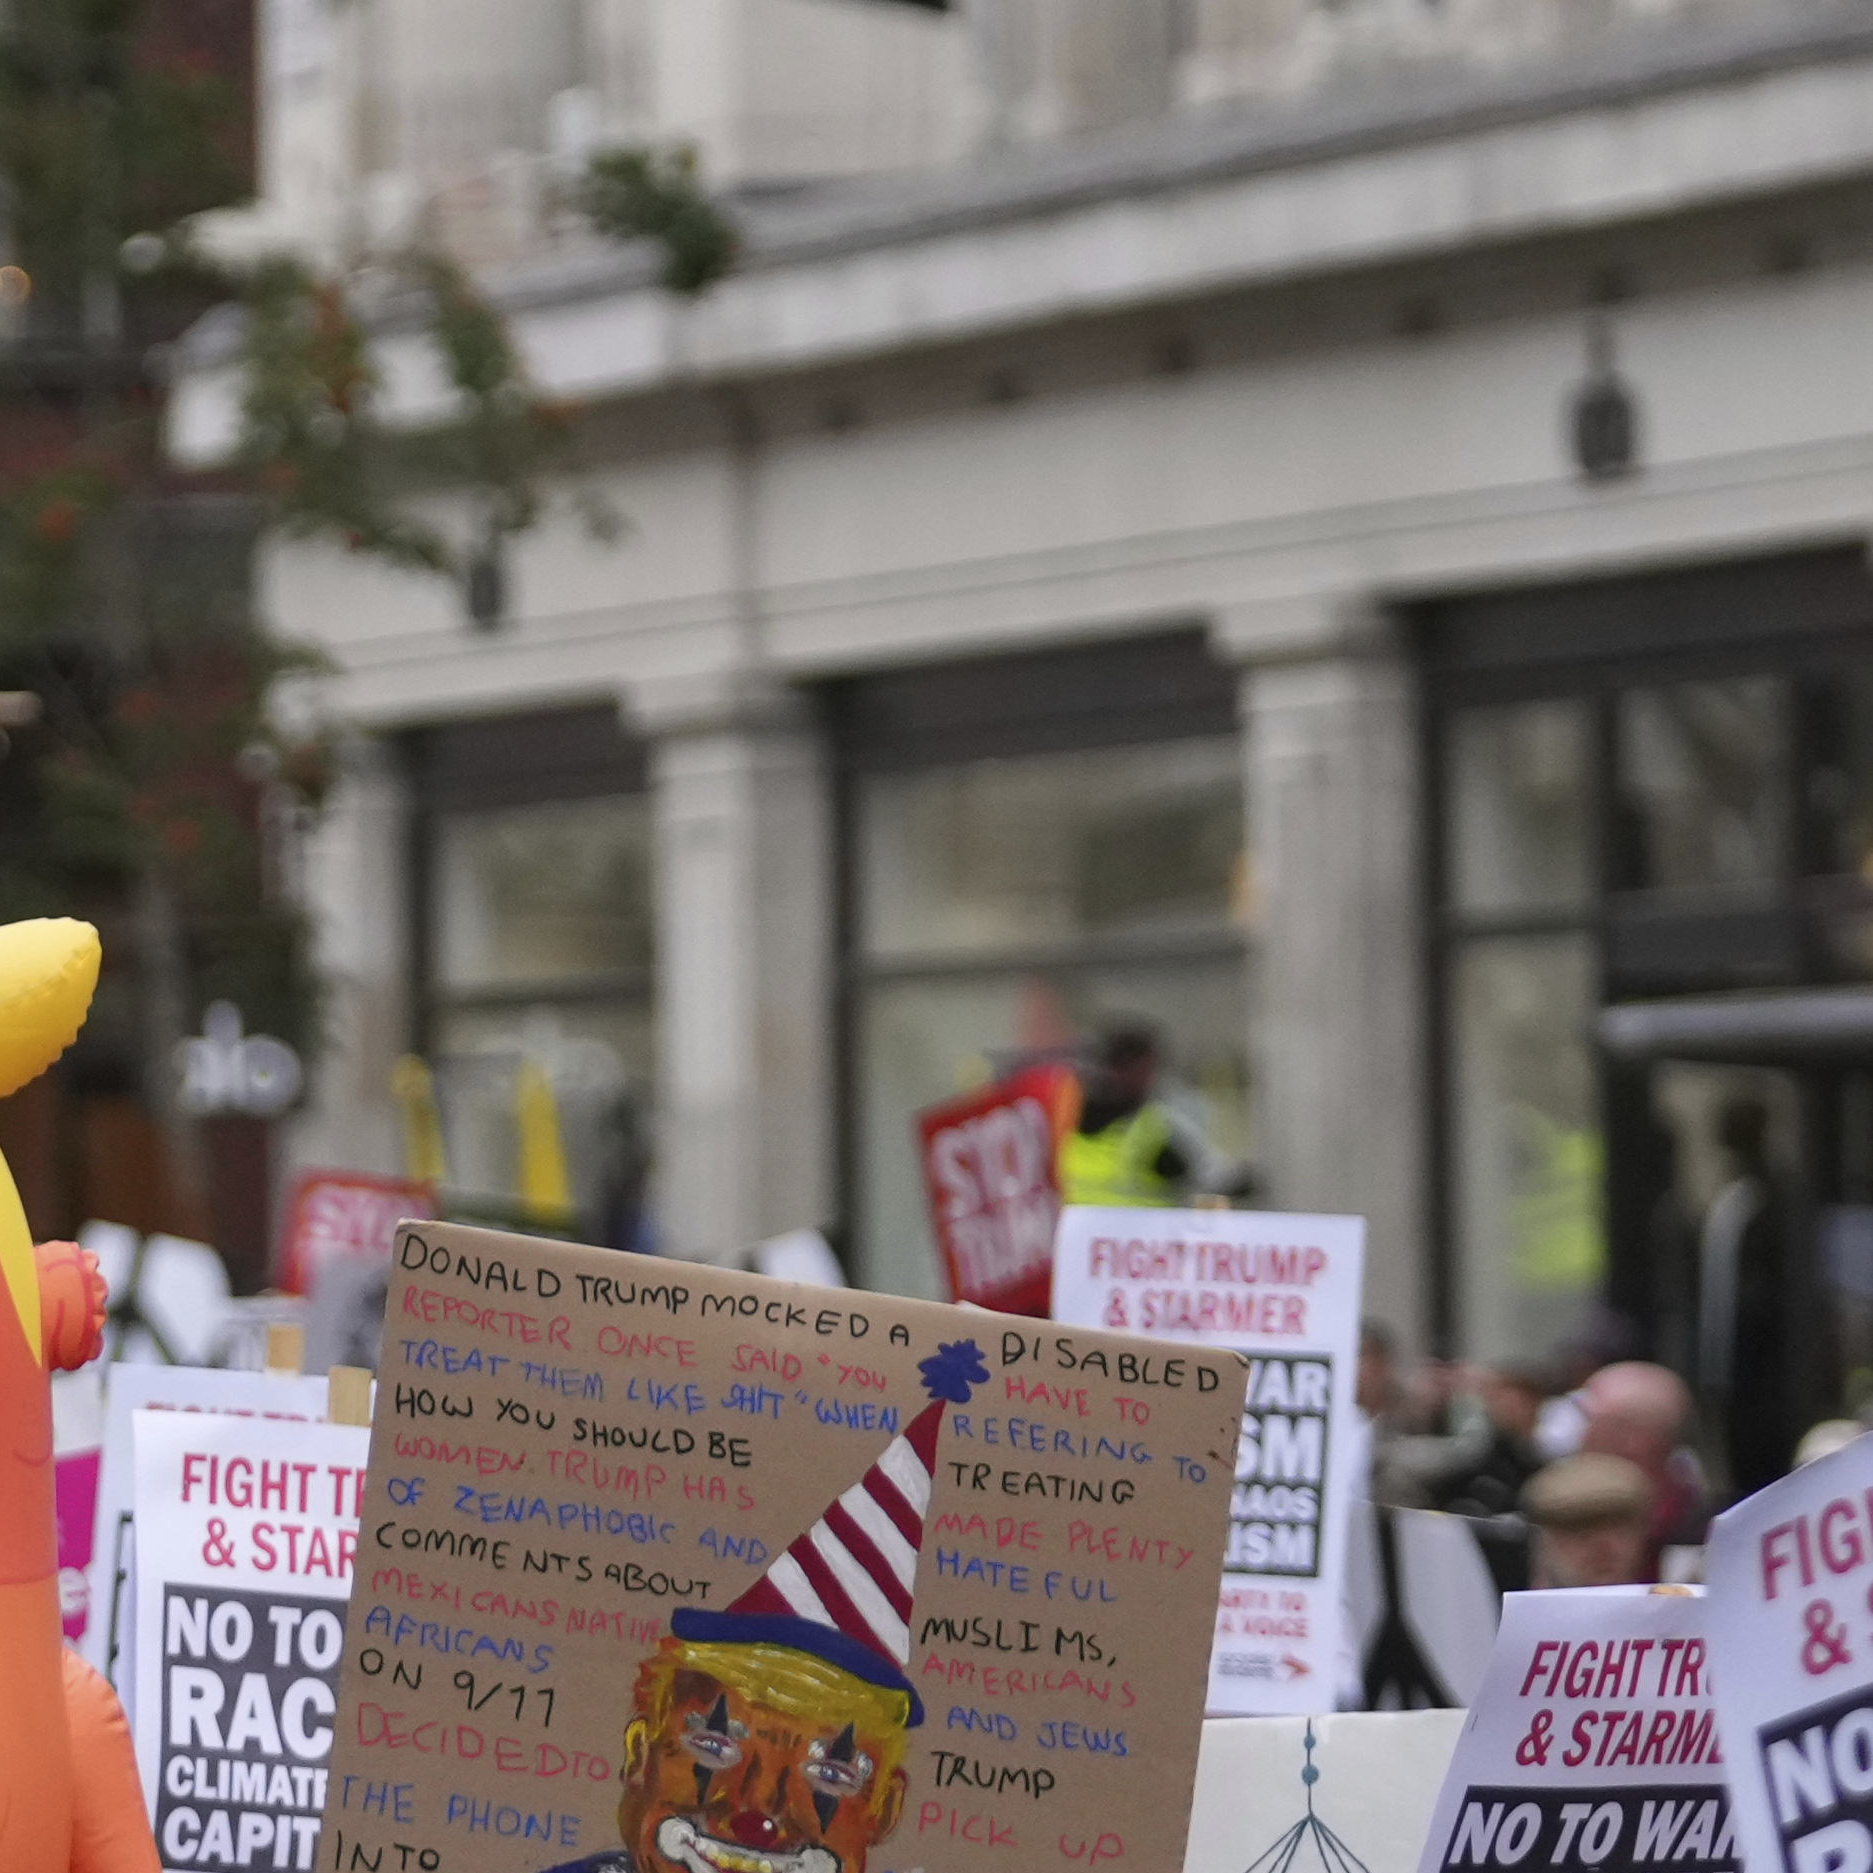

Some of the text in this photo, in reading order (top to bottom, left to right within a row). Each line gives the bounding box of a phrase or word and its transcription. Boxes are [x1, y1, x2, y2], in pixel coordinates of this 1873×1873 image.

[1090, 1238, 1327, 1286] FIGHT TRUMP
[401, 1234, 1219, 1392] DONALD TRUMP MOCKED A DISABLED
[1108, 1290, 1306, 1335] & STARMER
[402, 1285, 571, 1352] REPORTER
[597, 1326, 698, 1368] ONCE
[731, 1343, 802, 1382] SAID
[1006, 1376, 1090, 1416] HAVE
[1114, 1397, 1150, 1425] TO
[396, 1383, 1135, 1504] HOW YOU SHOULD BE TREATING
[182, 1454, 316, 1512] FIGHT
[202, 1518, 235, 1567] &
[377, 1521, 593, 1583] COMMENTS
[605, 1563, 711, 1600] ABOUT
[167, 1596, 342, 1669] NO TO
[365, 1605, 1128, 1757] AFRICANS AND JEWS
[360, 1649, 1054, 1799] ON 9/11 TRUMP
[343, 1775, 415, 1824] THE
[447, 1794, 581, 1847] PHONE
[919, 1801, 1018, 1846] PICK
[1059, 1833, 1124, 1865] UP
[1449, 1802, 1623, 1865] NO TO
[335, 1830, 440, 1873] INTO
